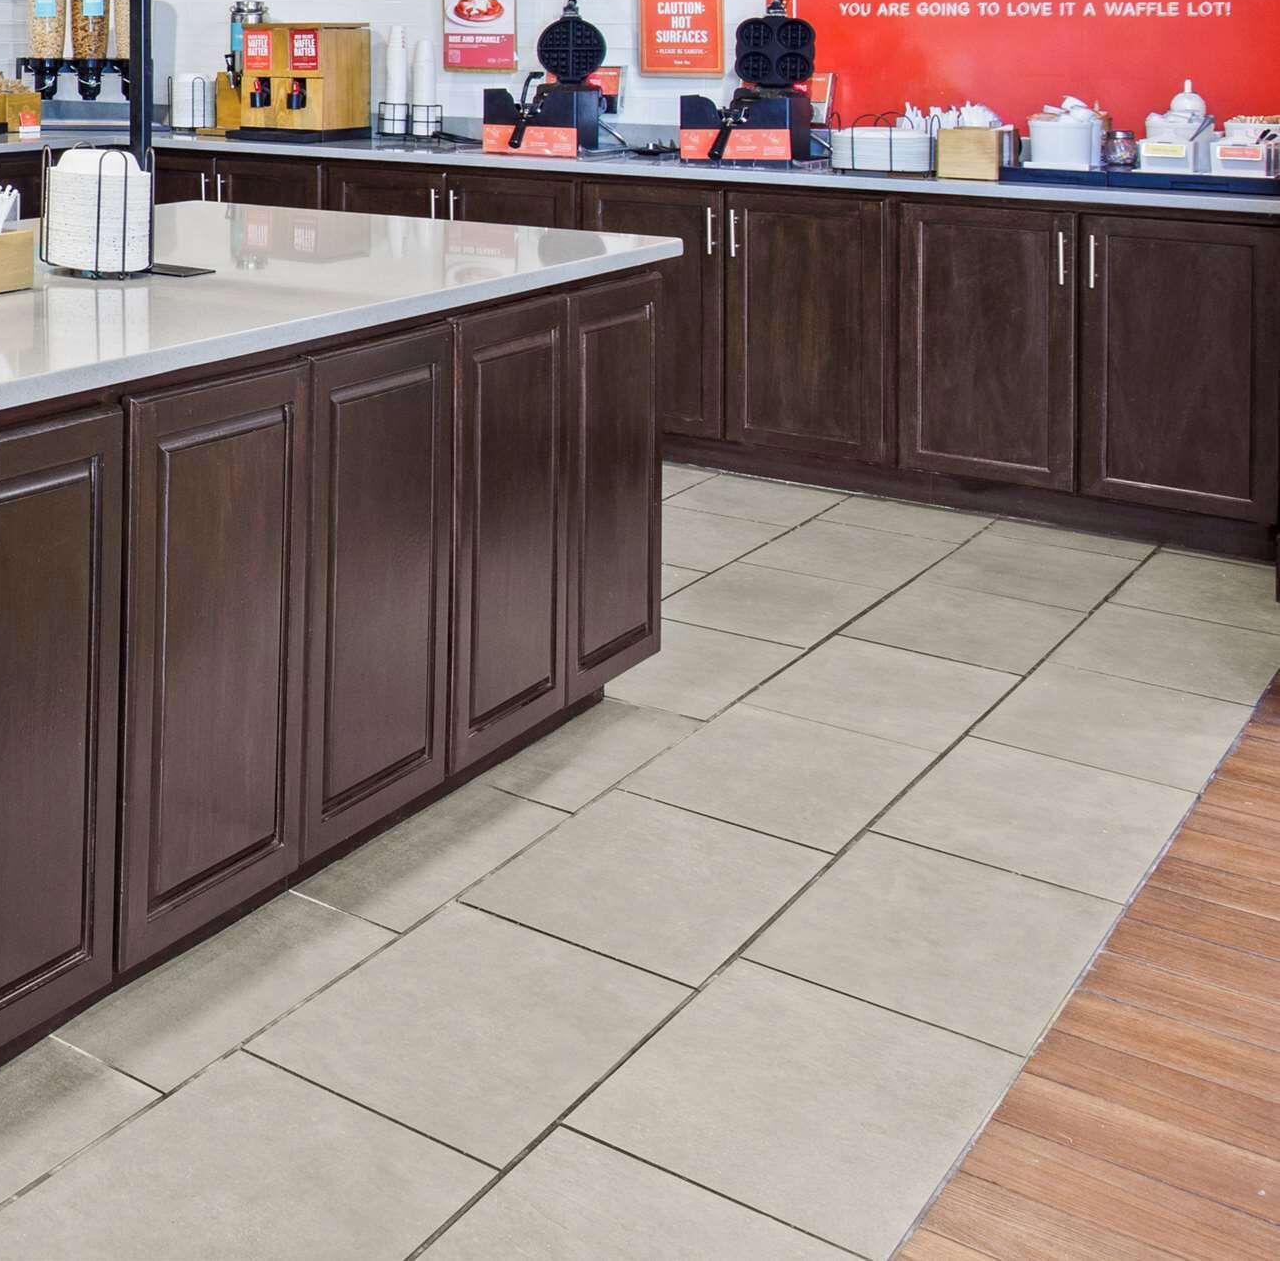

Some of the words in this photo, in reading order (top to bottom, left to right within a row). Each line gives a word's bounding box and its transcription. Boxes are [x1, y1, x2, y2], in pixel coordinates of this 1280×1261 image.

[657, 1, 706, 14] CAUTION:
[839, 2, 873, 17] YOU
[877, 2, 910, 17] ARE
[917, 2, 972, 17] GOING
[978, 2, 1000, 17] TO
[1007, 2, 1053, 17] LOVE
[1059, 2, 1075, 17] IT
[1083, 2, 1095, 17] A
[1104, 2, 1179, 17] WAFFLE
[1187, 2, 1232, 17] LOT!
[671, 16, 691, 29] HOT
[656, 29, 708, 43] SURFACES
